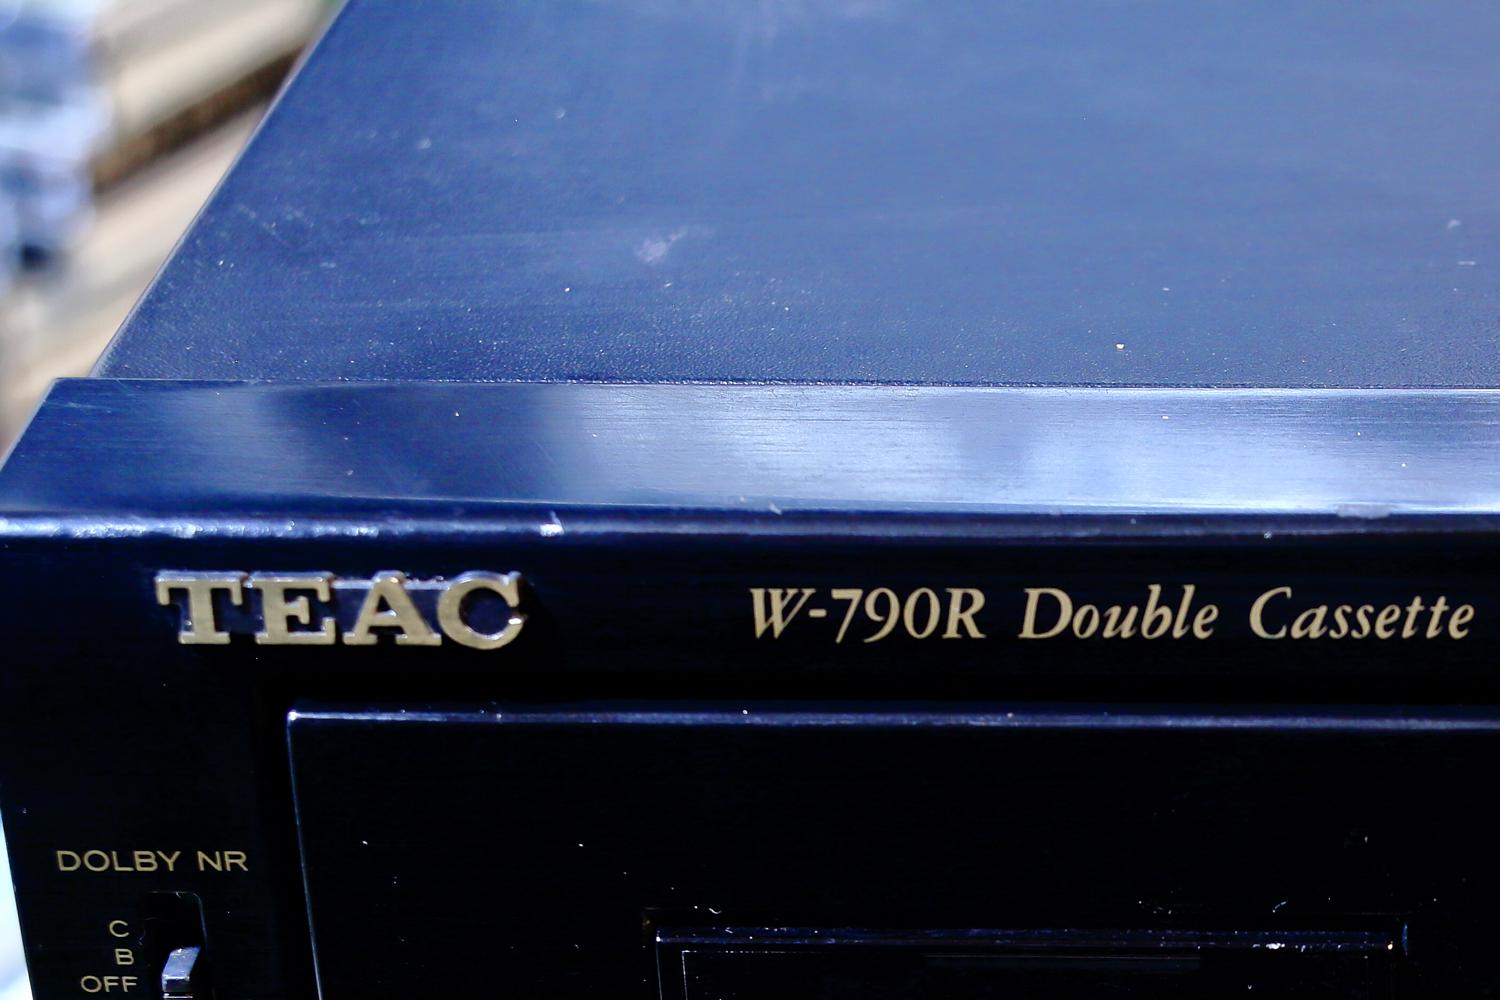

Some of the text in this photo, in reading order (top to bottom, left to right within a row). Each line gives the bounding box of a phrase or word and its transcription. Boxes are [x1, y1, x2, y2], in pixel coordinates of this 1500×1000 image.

[153, 568, 524, 650] TEAC
[749, 587, 986, 643] W-790R
[1018, 583, 1219, 640] Double
[1249, 586, 1475, 640] Cassette
[56, 849, 249, 872] DOLBY NR
[109, 919, 130, 938] C
[114, 948, 135, 966] B
[80, 975, 138, 993] OFF
